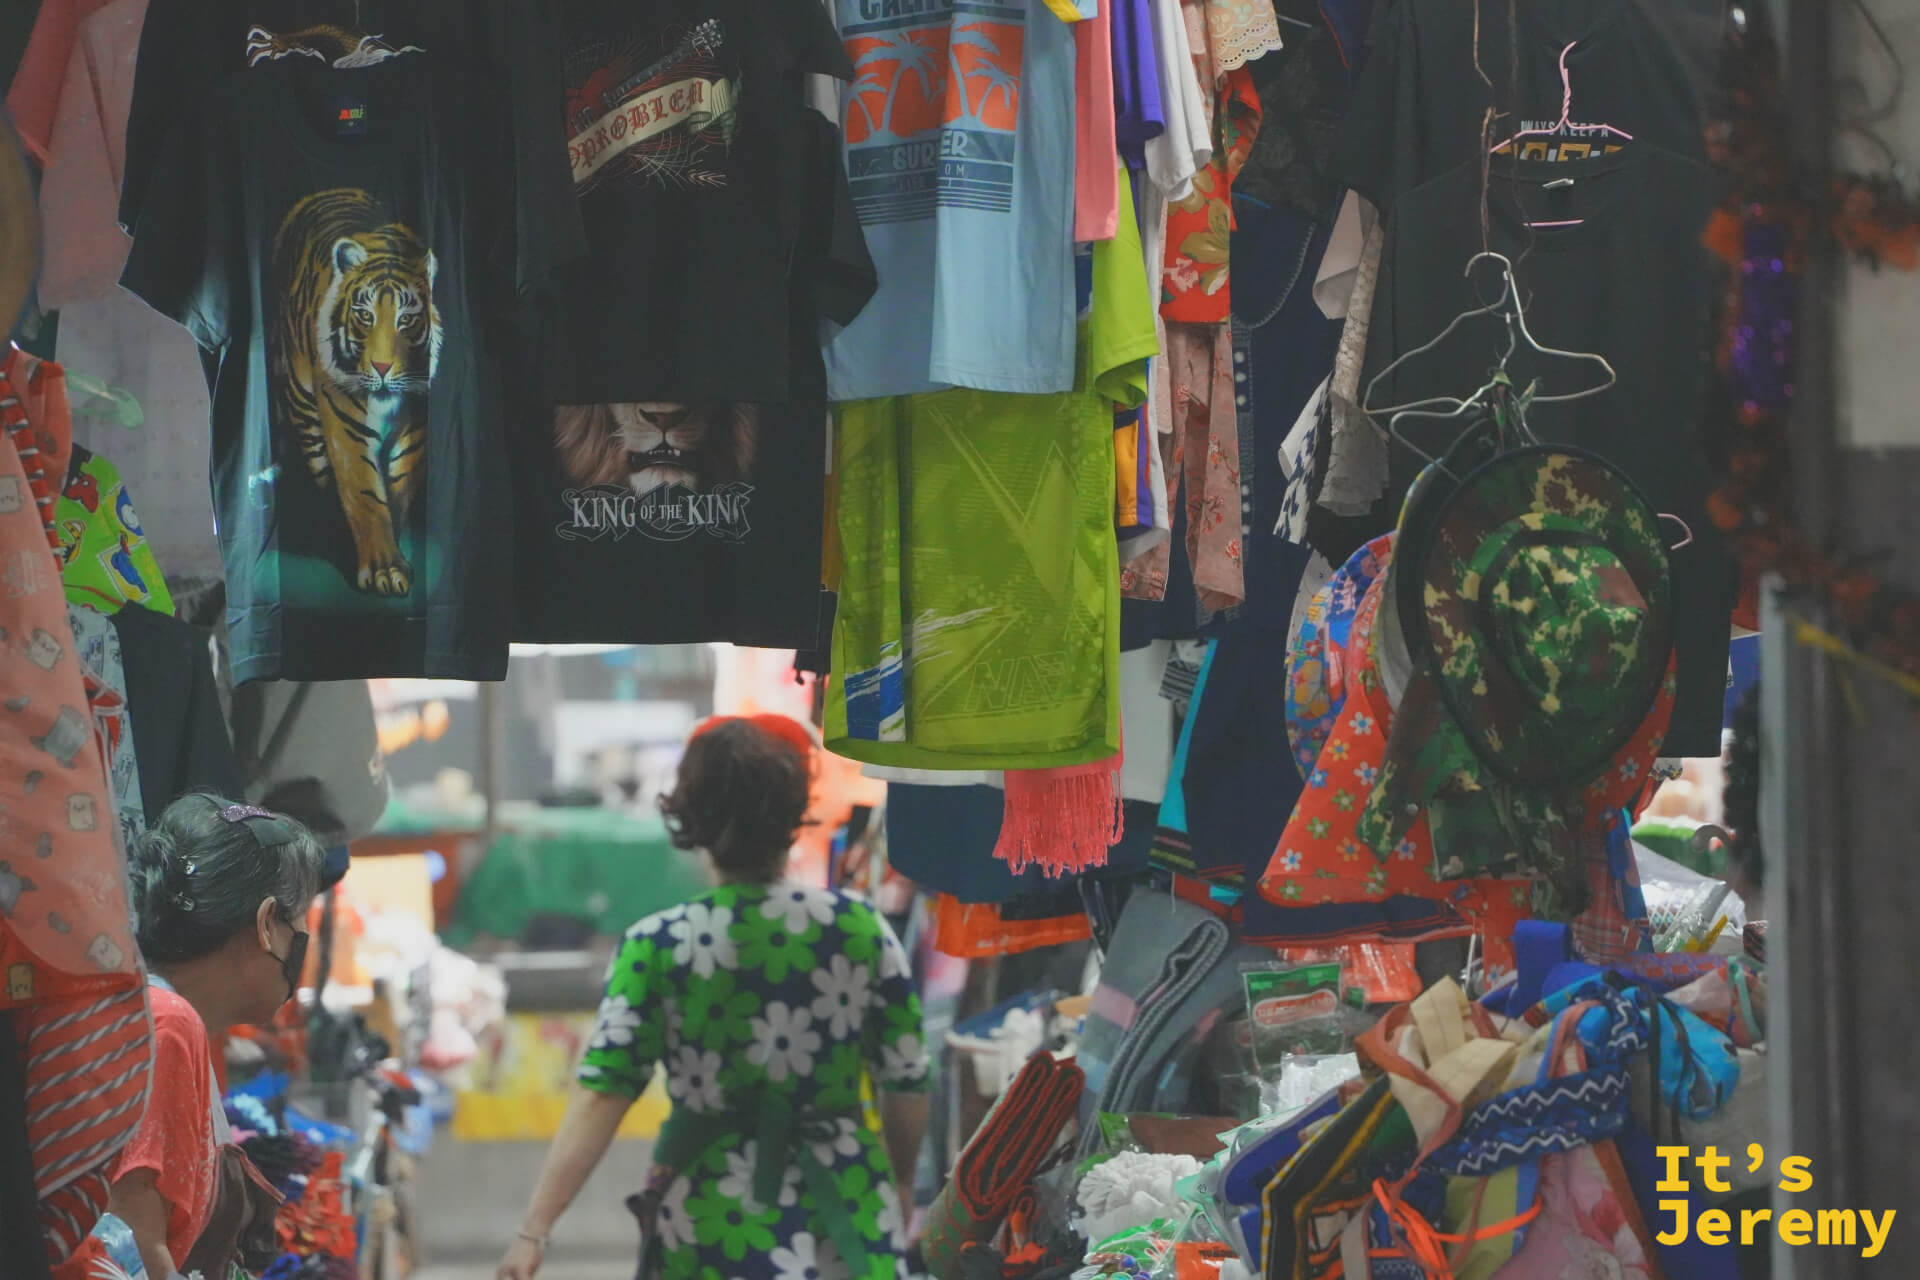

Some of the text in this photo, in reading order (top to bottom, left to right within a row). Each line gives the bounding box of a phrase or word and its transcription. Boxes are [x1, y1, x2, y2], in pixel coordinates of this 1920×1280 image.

[572, 496, 636, 528] KING
[640, 504, 656, 521] OF
[658, 503, 684, 520] THE
